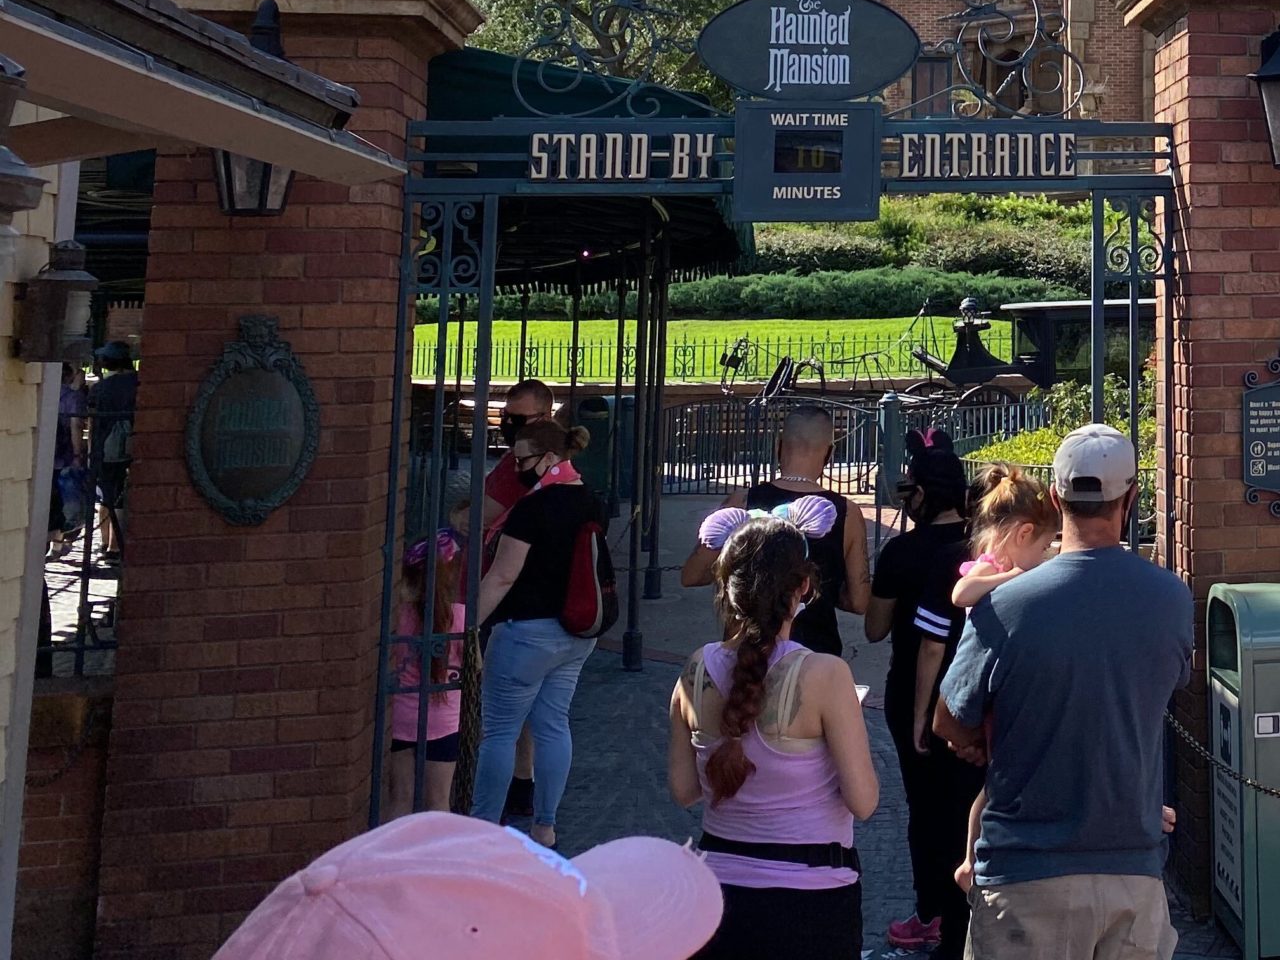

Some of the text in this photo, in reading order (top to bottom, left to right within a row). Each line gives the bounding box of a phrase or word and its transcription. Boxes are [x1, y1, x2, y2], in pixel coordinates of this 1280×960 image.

[769, 5, 851, 45] Haunted
[764, 47, 850, 92] Mansion
[771, 113, 849, 126] WAIT TIME
[530, 133, 715, 179] STAND-BY
[794, 145, 825, 169] 10
[901, 133, 1075, 178] ENTRANCE
[772, 186, 841, 199] MINUTES
